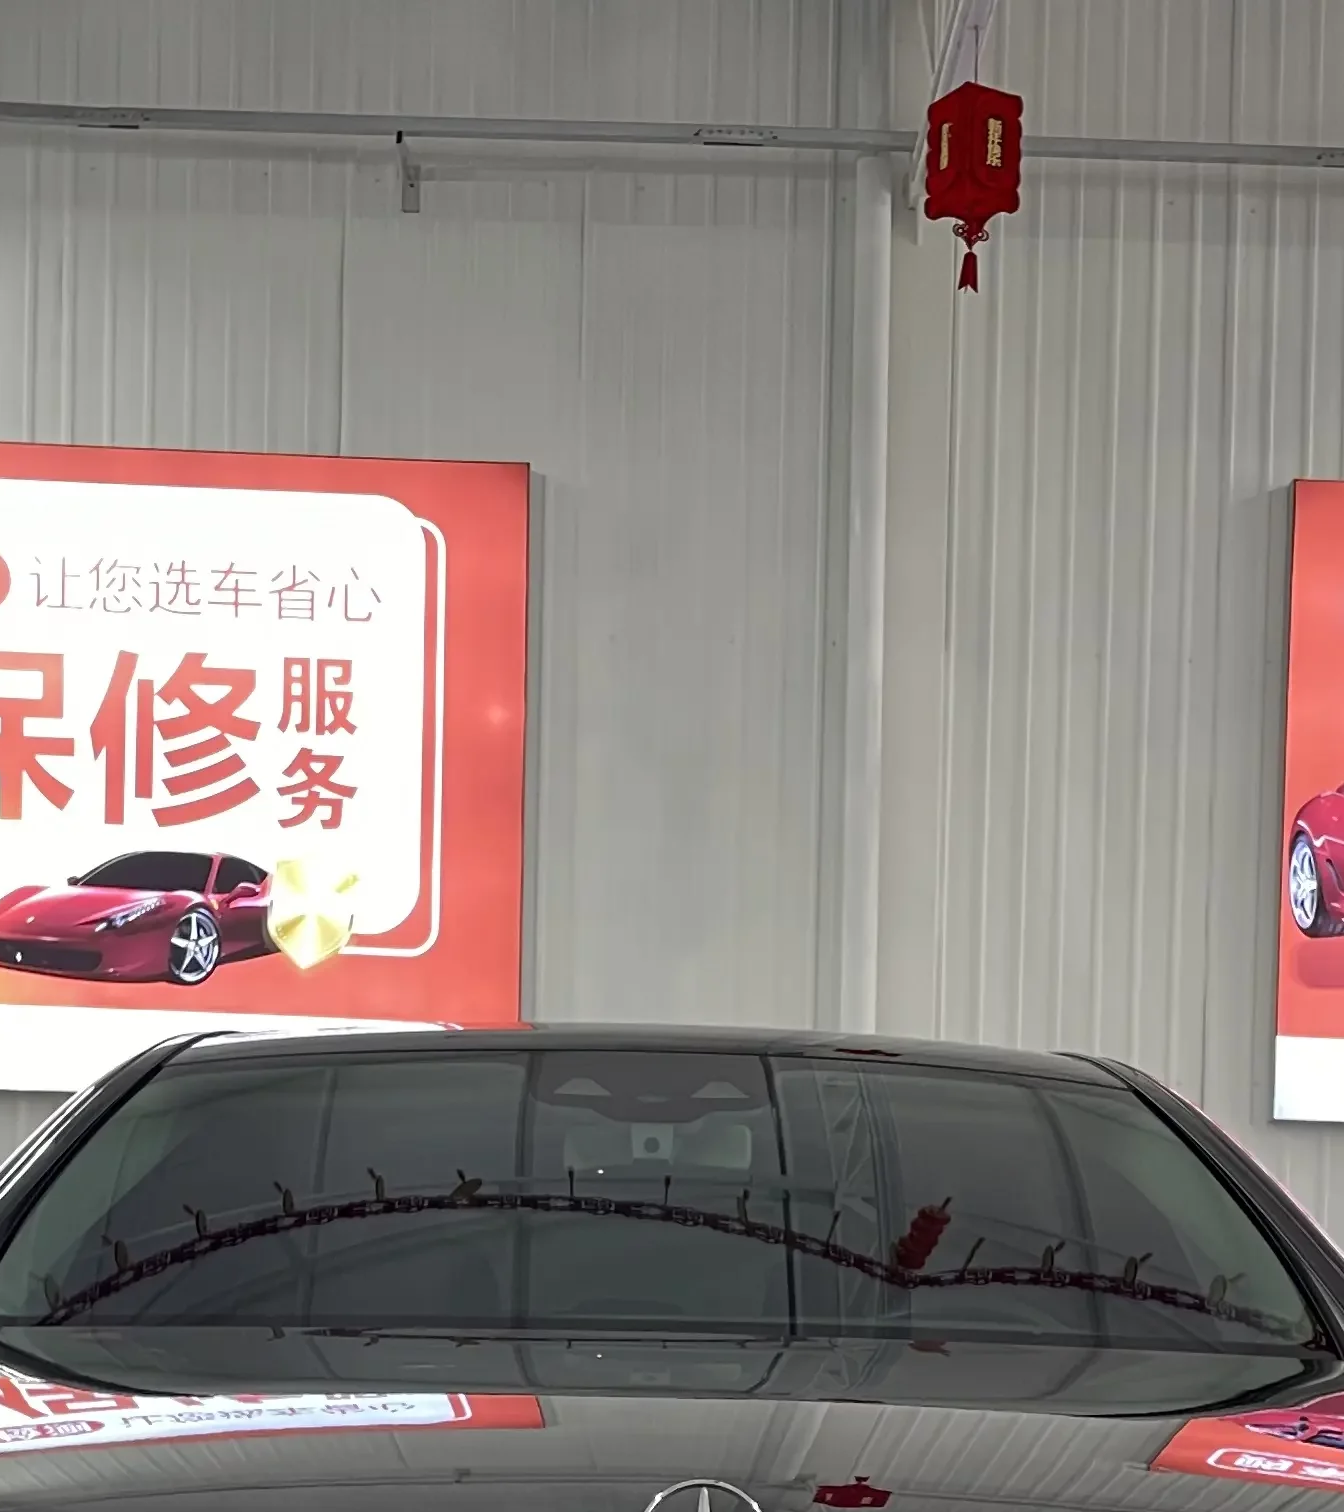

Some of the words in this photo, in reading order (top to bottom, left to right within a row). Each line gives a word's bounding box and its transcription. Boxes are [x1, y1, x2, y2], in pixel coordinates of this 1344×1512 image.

[30, 555, 382, 623] 让您选车省心
